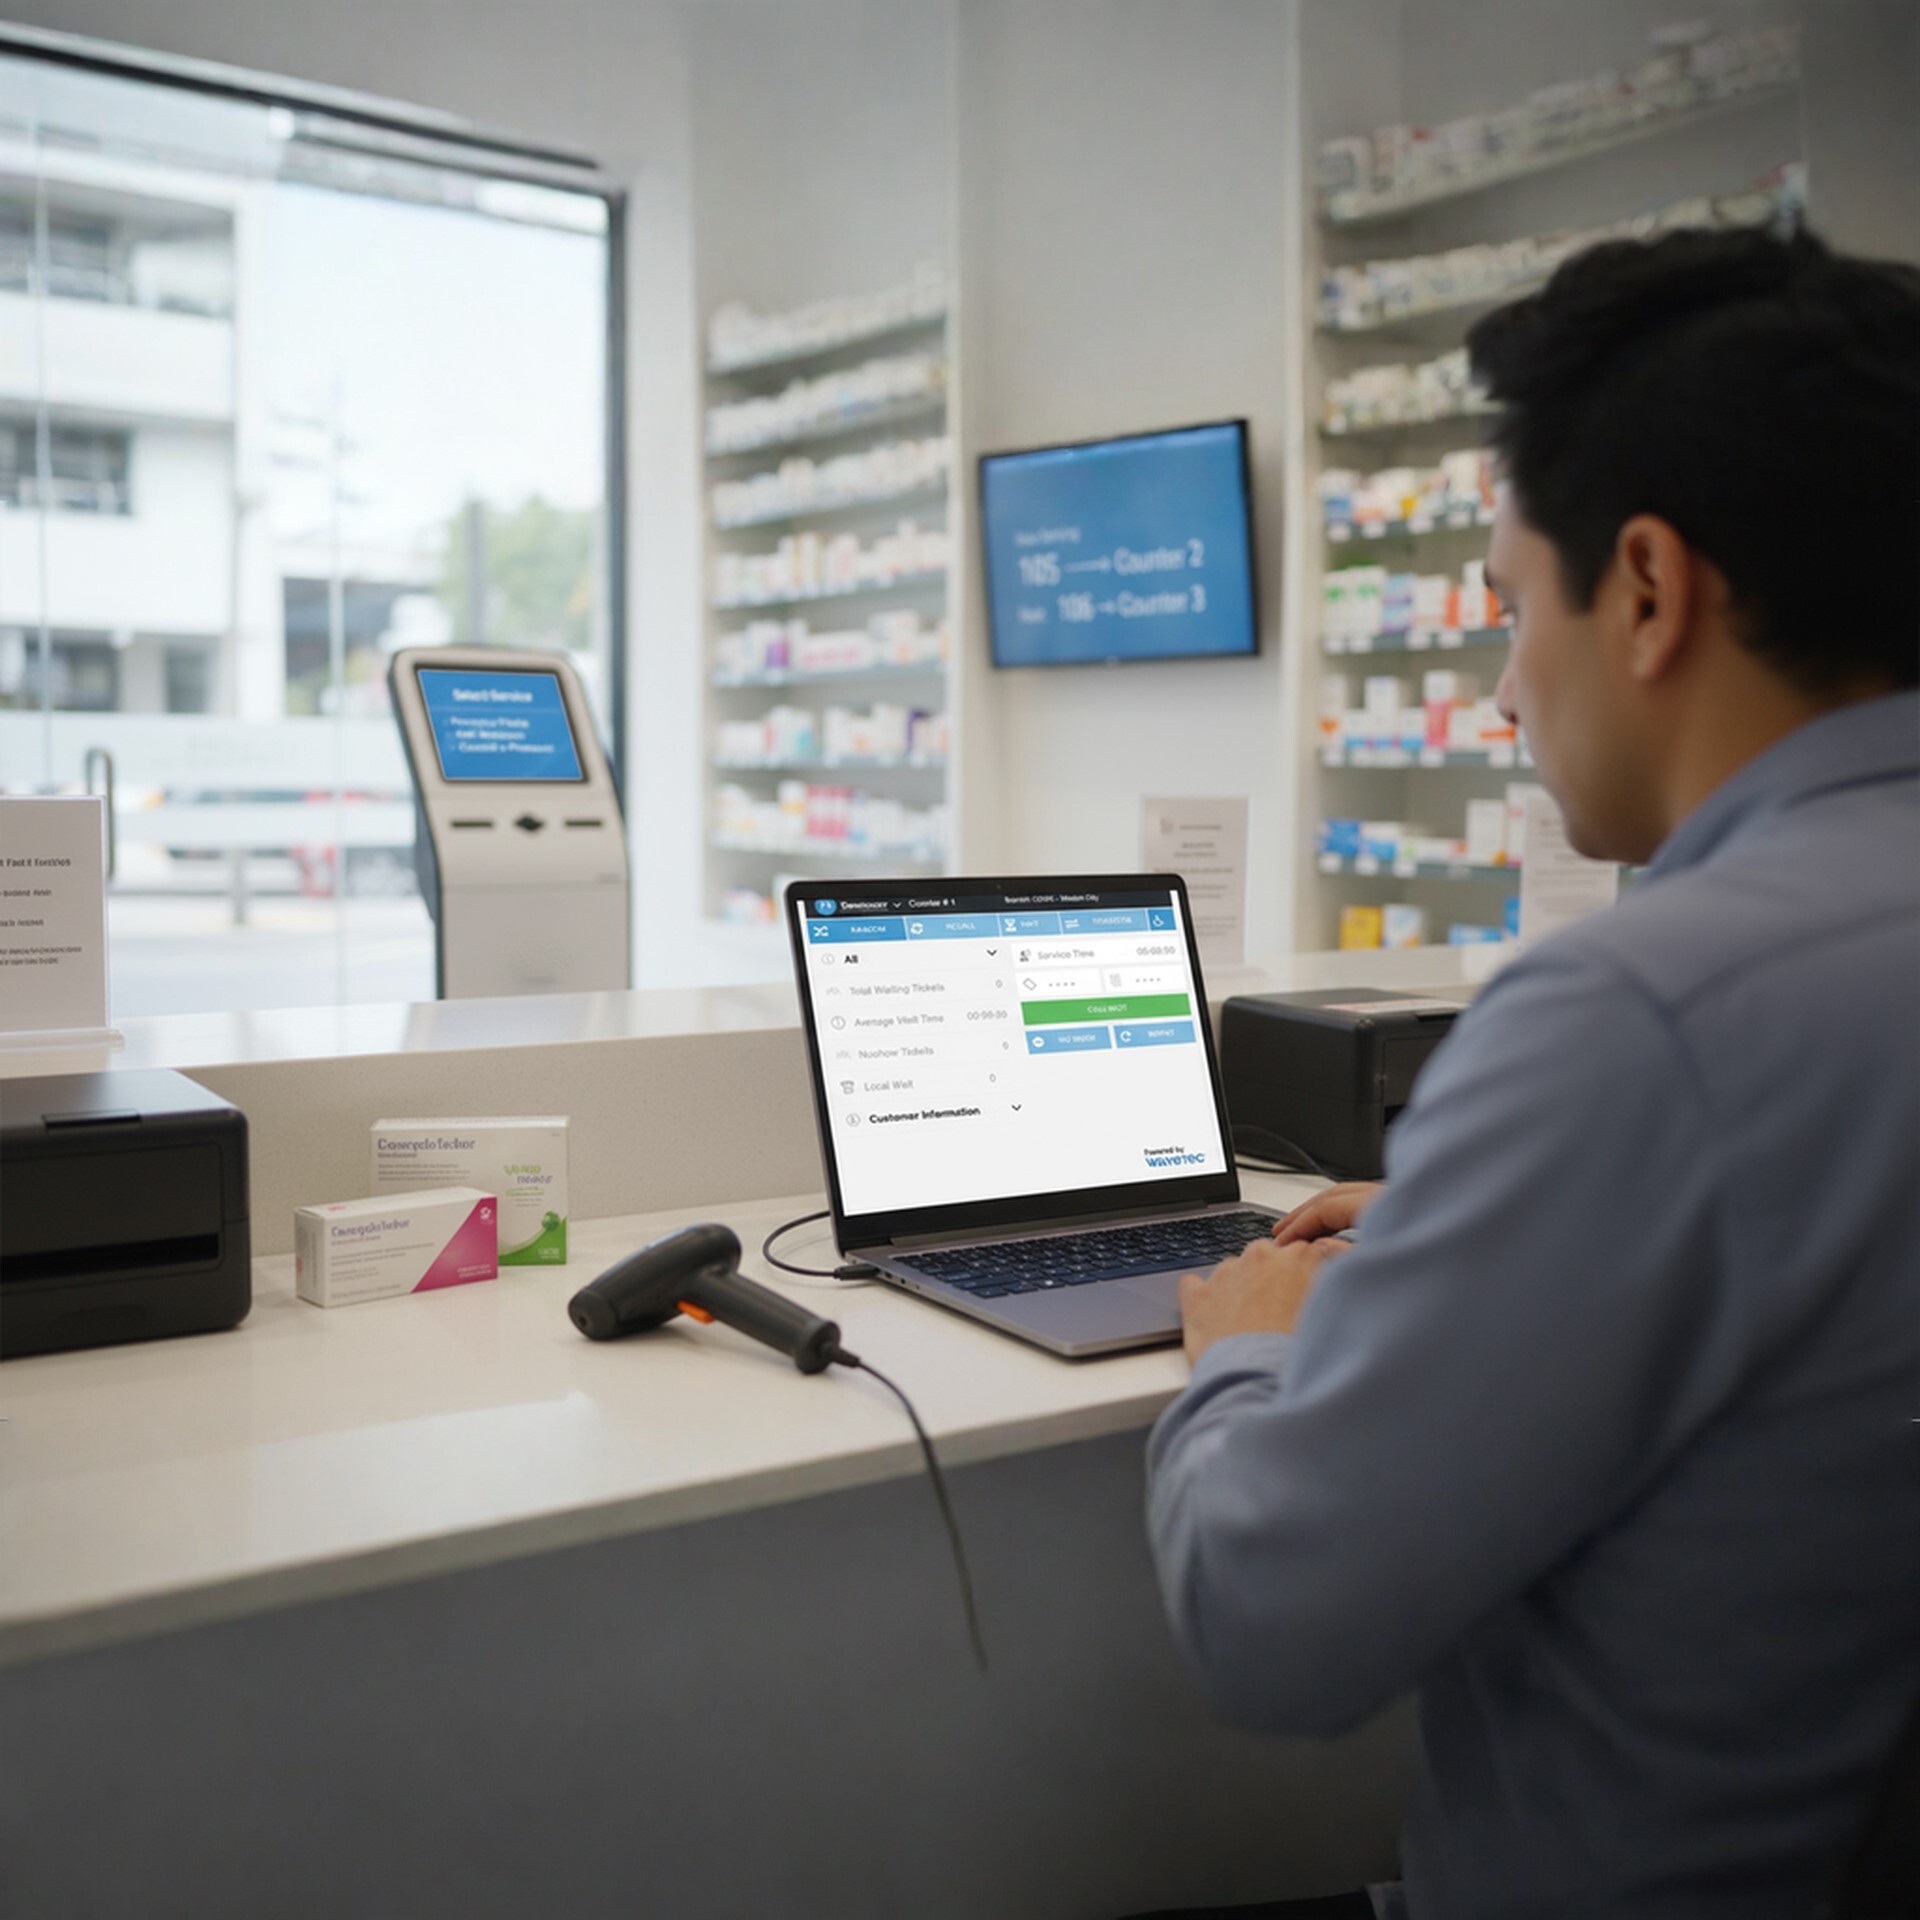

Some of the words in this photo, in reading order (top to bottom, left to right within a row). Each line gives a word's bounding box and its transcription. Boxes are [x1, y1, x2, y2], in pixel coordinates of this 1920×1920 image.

[1019, 552, 1060, 586] 105
[1114, 547, 1185, 575] Counter
[1188, 538, 1204, 567] 2
[1117, 591, 1187, 618] Counter
[1190, 583, 1206, 613] 3
[844, 955, 858, 964] All
[989, 1073, 996, 1083] 0
[864, 1081, 890, 1092] Local
[869, 1111, 919, 1124] Customer
[921, 1107, 981, 1119] Information
